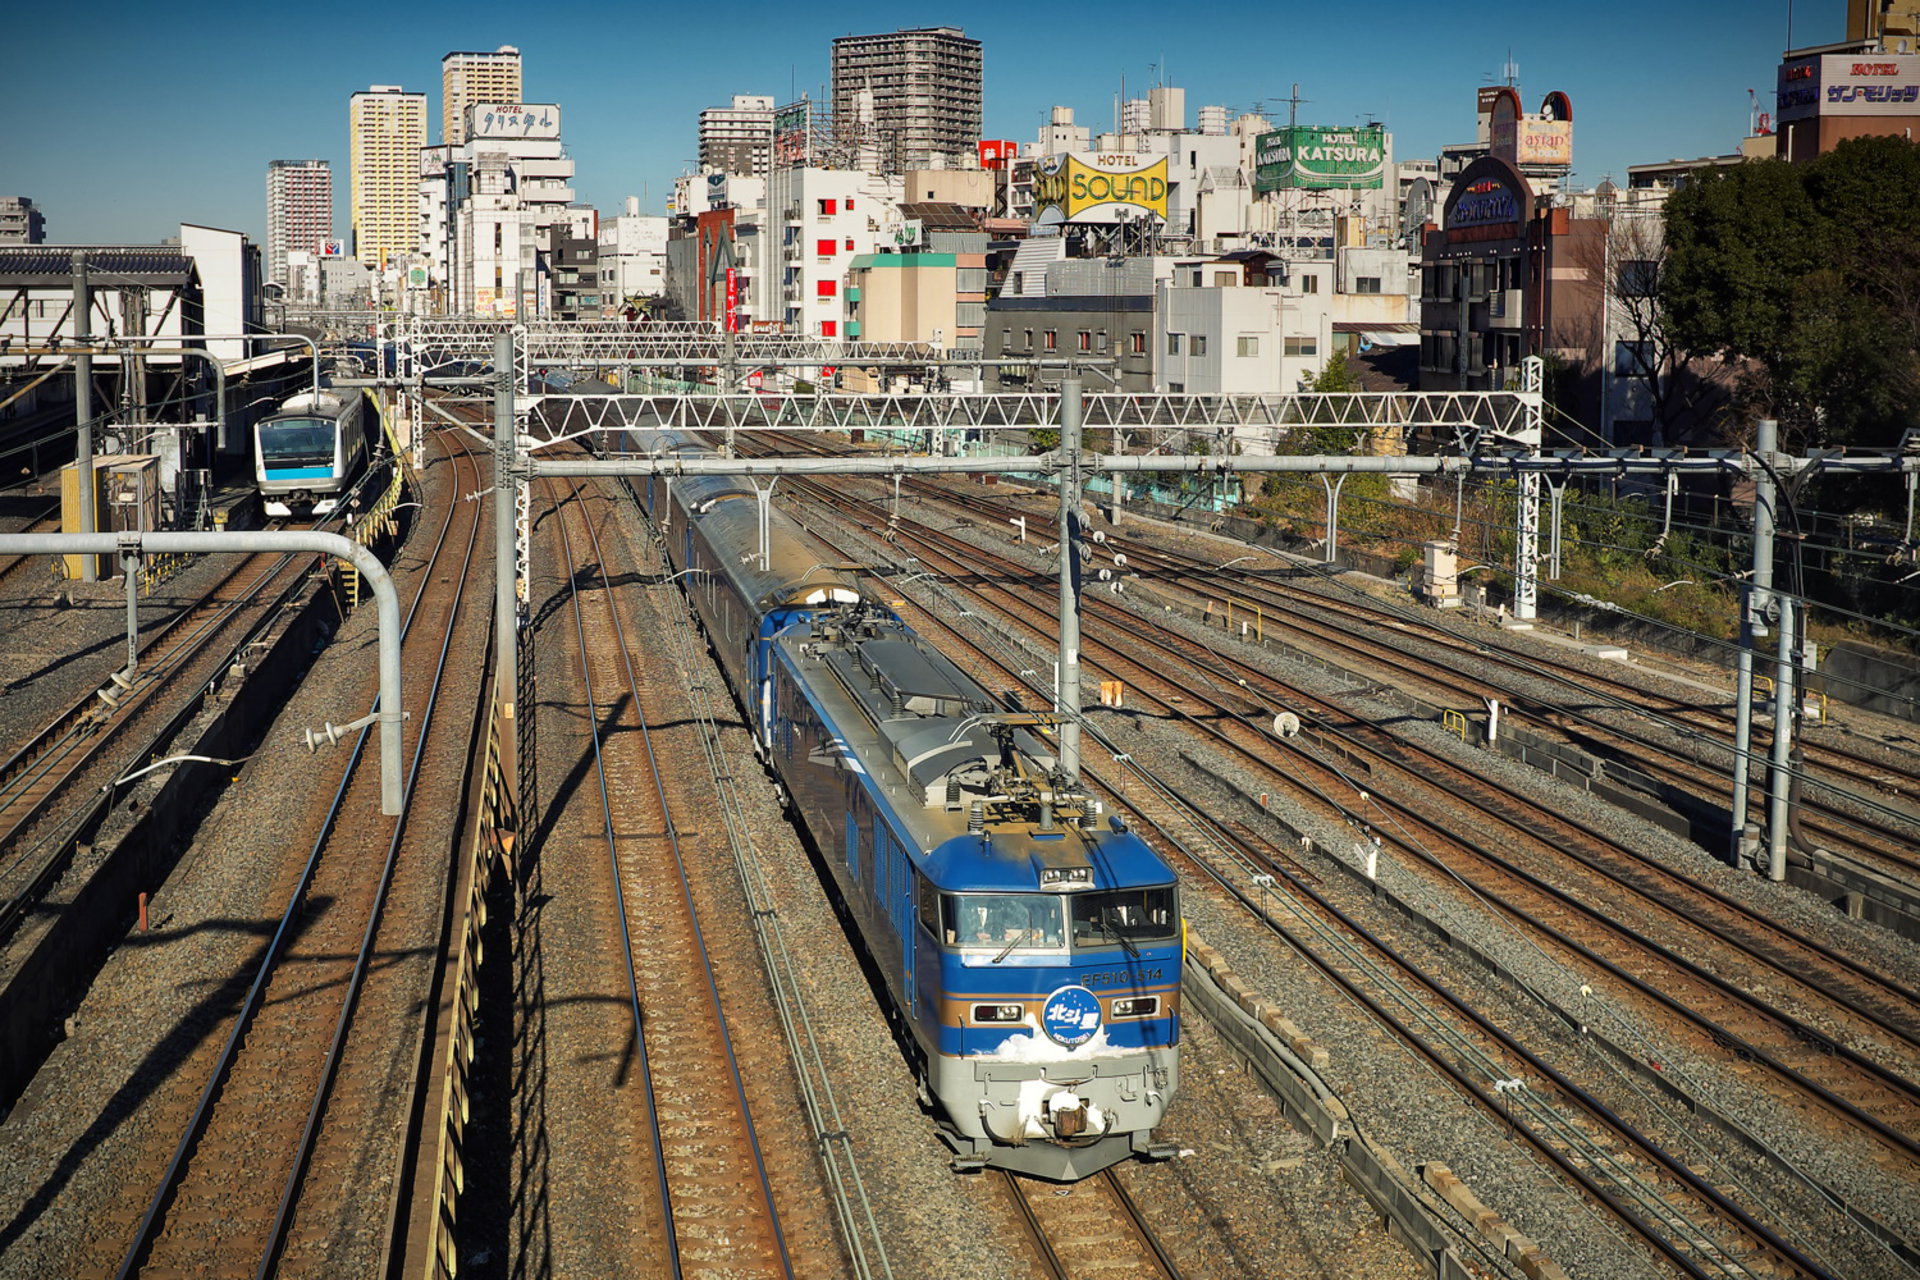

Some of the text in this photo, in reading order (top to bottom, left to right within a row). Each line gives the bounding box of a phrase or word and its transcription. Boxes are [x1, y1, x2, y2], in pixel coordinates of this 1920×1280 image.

[1850, 63, 1899, 76] HOTEL
[496, 105, 522, 113] HOTEL
[484, 108, 553, 136] クリスタル
[1322, 134, 1357, 144] HOTEL
[1097, 155, 1138, 166] HOTEL
[1297, 146, 1380, 162] KATSURA
[1072, 174, 1165, 201] SOUND
[1081, 968, 1163, 987] EF510-514
[1047, 1003, 1099, 1030] 北斗星
